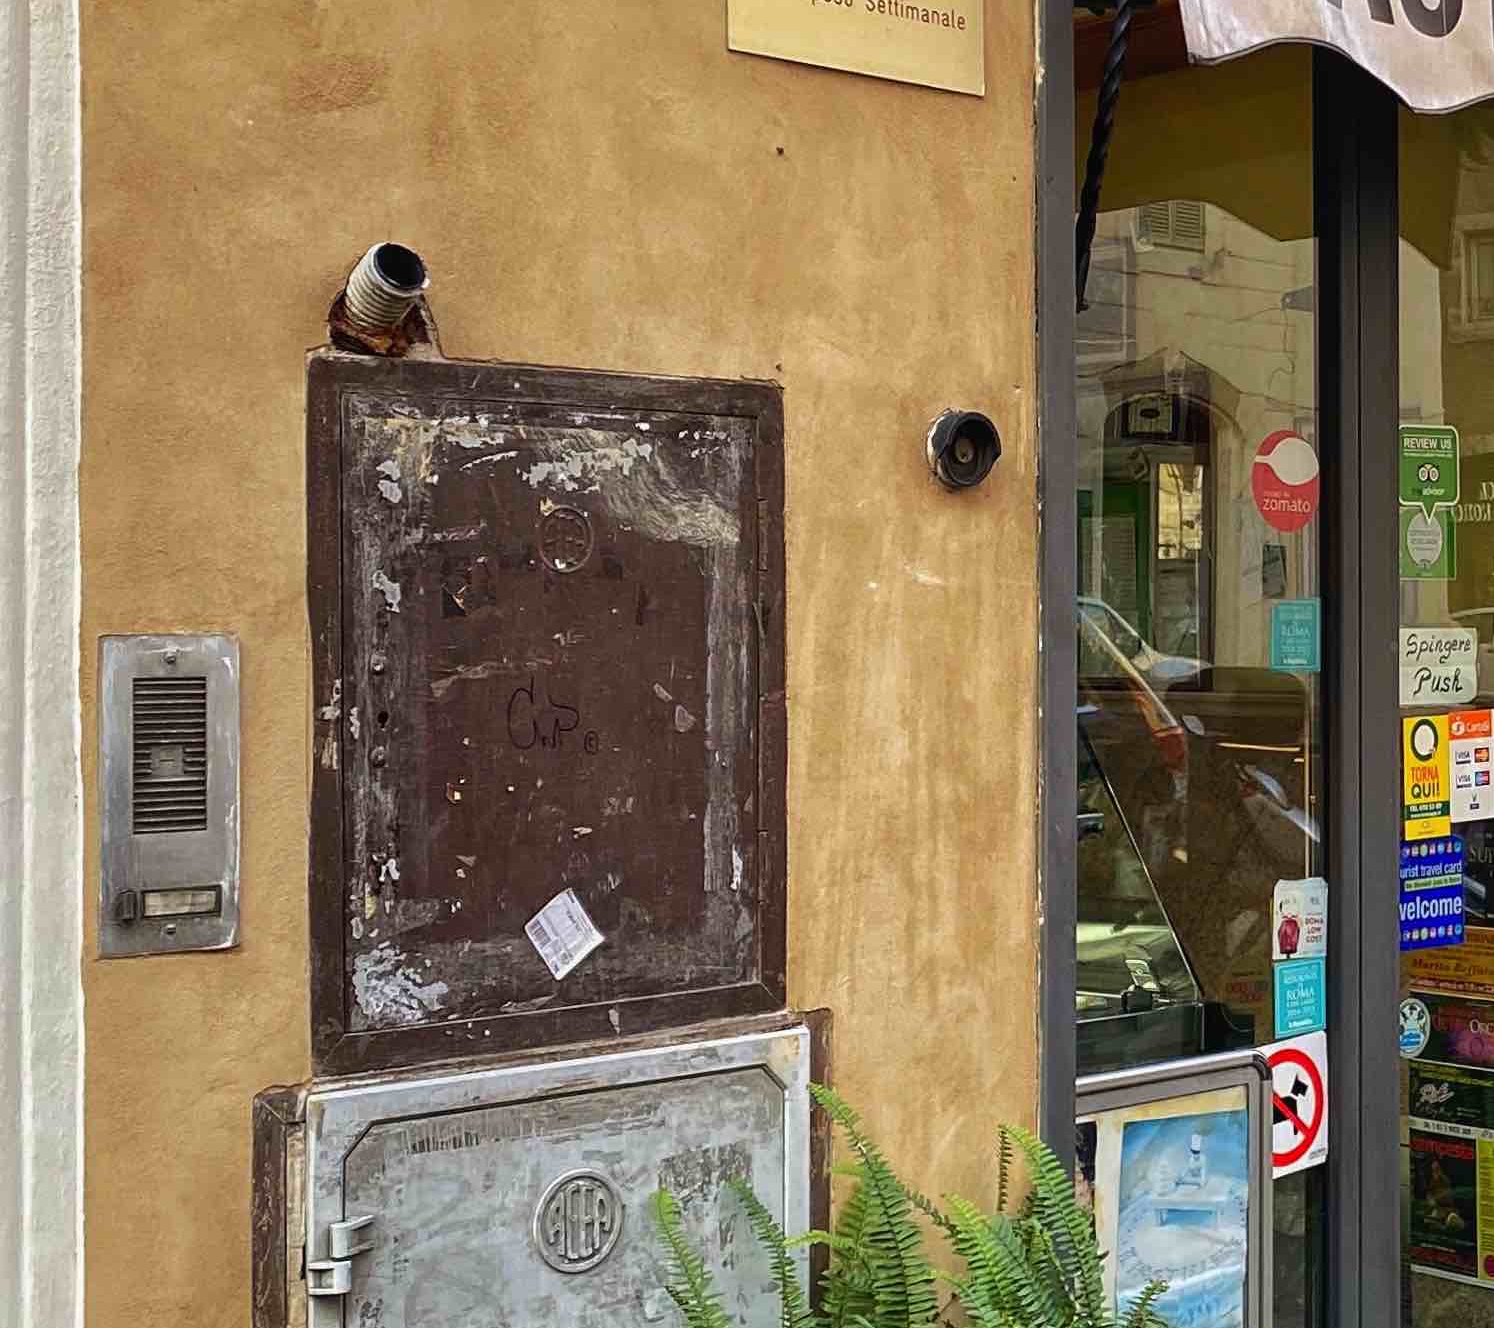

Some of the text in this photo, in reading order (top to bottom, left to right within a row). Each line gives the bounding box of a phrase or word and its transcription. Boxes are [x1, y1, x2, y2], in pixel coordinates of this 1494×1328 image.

[1403, 437, 1452, 450] REVIEW US
[1263, 497, 1311, 514] zomato
[1406, 634, 1472, 665] Spingere
[1413, 666, 1464, 696] Push
[1410, 766, 1439, 783] TORNA
[1411, 782, 1440, 799] QUI!
[1420, 862, 1443, 877] travel
[1443, 860, 1463, 874] card
[1305, 934, 1323, 944] COST
[1306, 926, 1322, 935] LOW
[547, 1179, 611, 1261] ACEA
